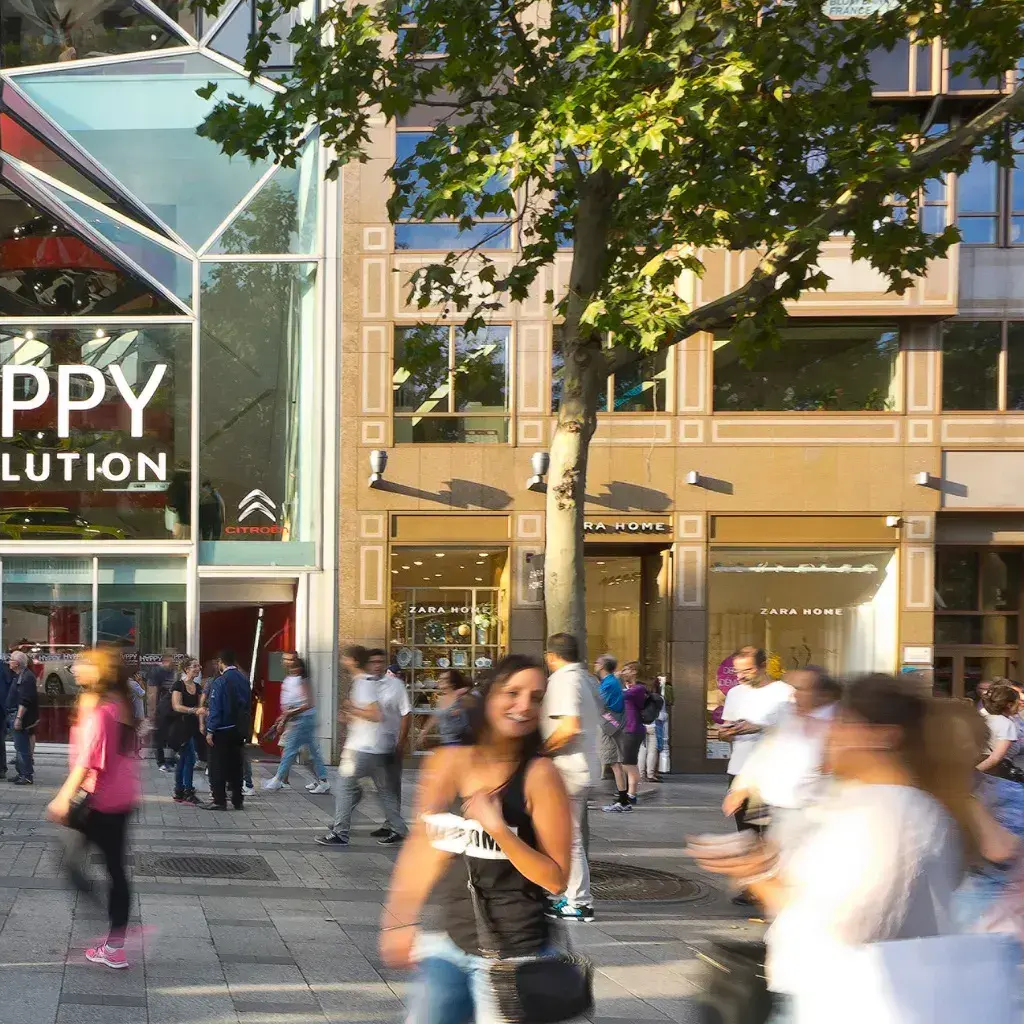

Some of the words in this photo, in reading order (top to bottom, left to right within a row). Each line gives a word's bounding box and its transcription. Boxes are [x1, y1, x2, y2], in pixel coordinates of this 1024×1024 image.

[830, 6, 872, 15] FRANCE
[584, 521, 607, 530] RA
[615, 522, 666, 531] HOME
[409, 606, 446, 614] ZARA
[760, 608, 798, 616] ZARA
[802, 608, 844, 616] HOME
